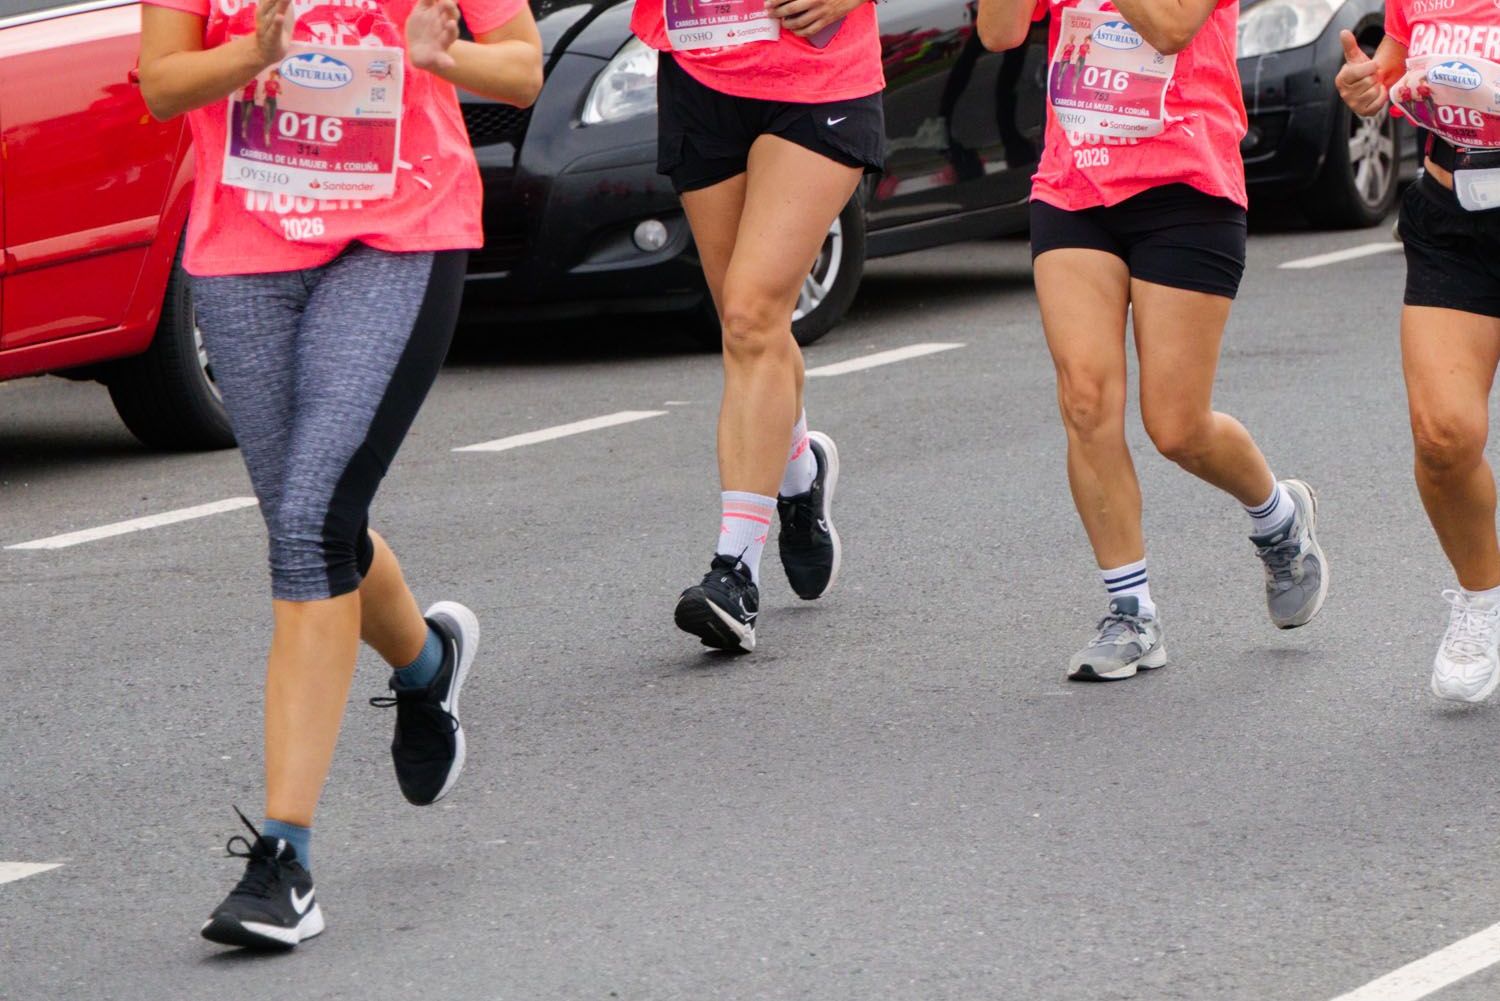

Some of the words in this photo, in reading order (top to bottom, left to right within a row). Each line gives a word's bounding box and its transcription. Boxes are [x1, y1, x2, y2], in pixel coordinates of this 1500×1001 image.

[675, 18, 699, 28] CARRERA
[700, 17, 708, 25] DE
[709, 16, 717, 24] LA
[718, 14, 739, 23] MUJER
[680, 31, 713, 43] OYSHO
[1095, 29, 1139, 45] ASTURIANA
[286, 62, 348, 82] ASTURIANA
[1083, 66, 1130, 91] 016
[1432, 70, 1477, 86] ASTURIANA
[1055, 98, 1077, 107] CARRERA
[1094, 103, 1114, 112] MUJER
[1124, 107, 1150, 117] CORUÑA
[1437, 105, 1485, 127] 016
[278, 111, 343, 142] 016
[1109, 119, 1148, 131] Santander
[240, 148, 273, 162] CARRERA
[275, 154, 285, 163] DE
[287, 156, 299, 167] LA
[299, 158, 328, 170] MUJER
[343, 161, 378, 171] CORUÑA
[297, 143, 320, 157] 314
[1074, 147, 1109, 169] 2026
[240, 166, 290, 185] OYSHO
[322, 181, 374, 191] Santander
[281, 217, 325, 241] 2026
